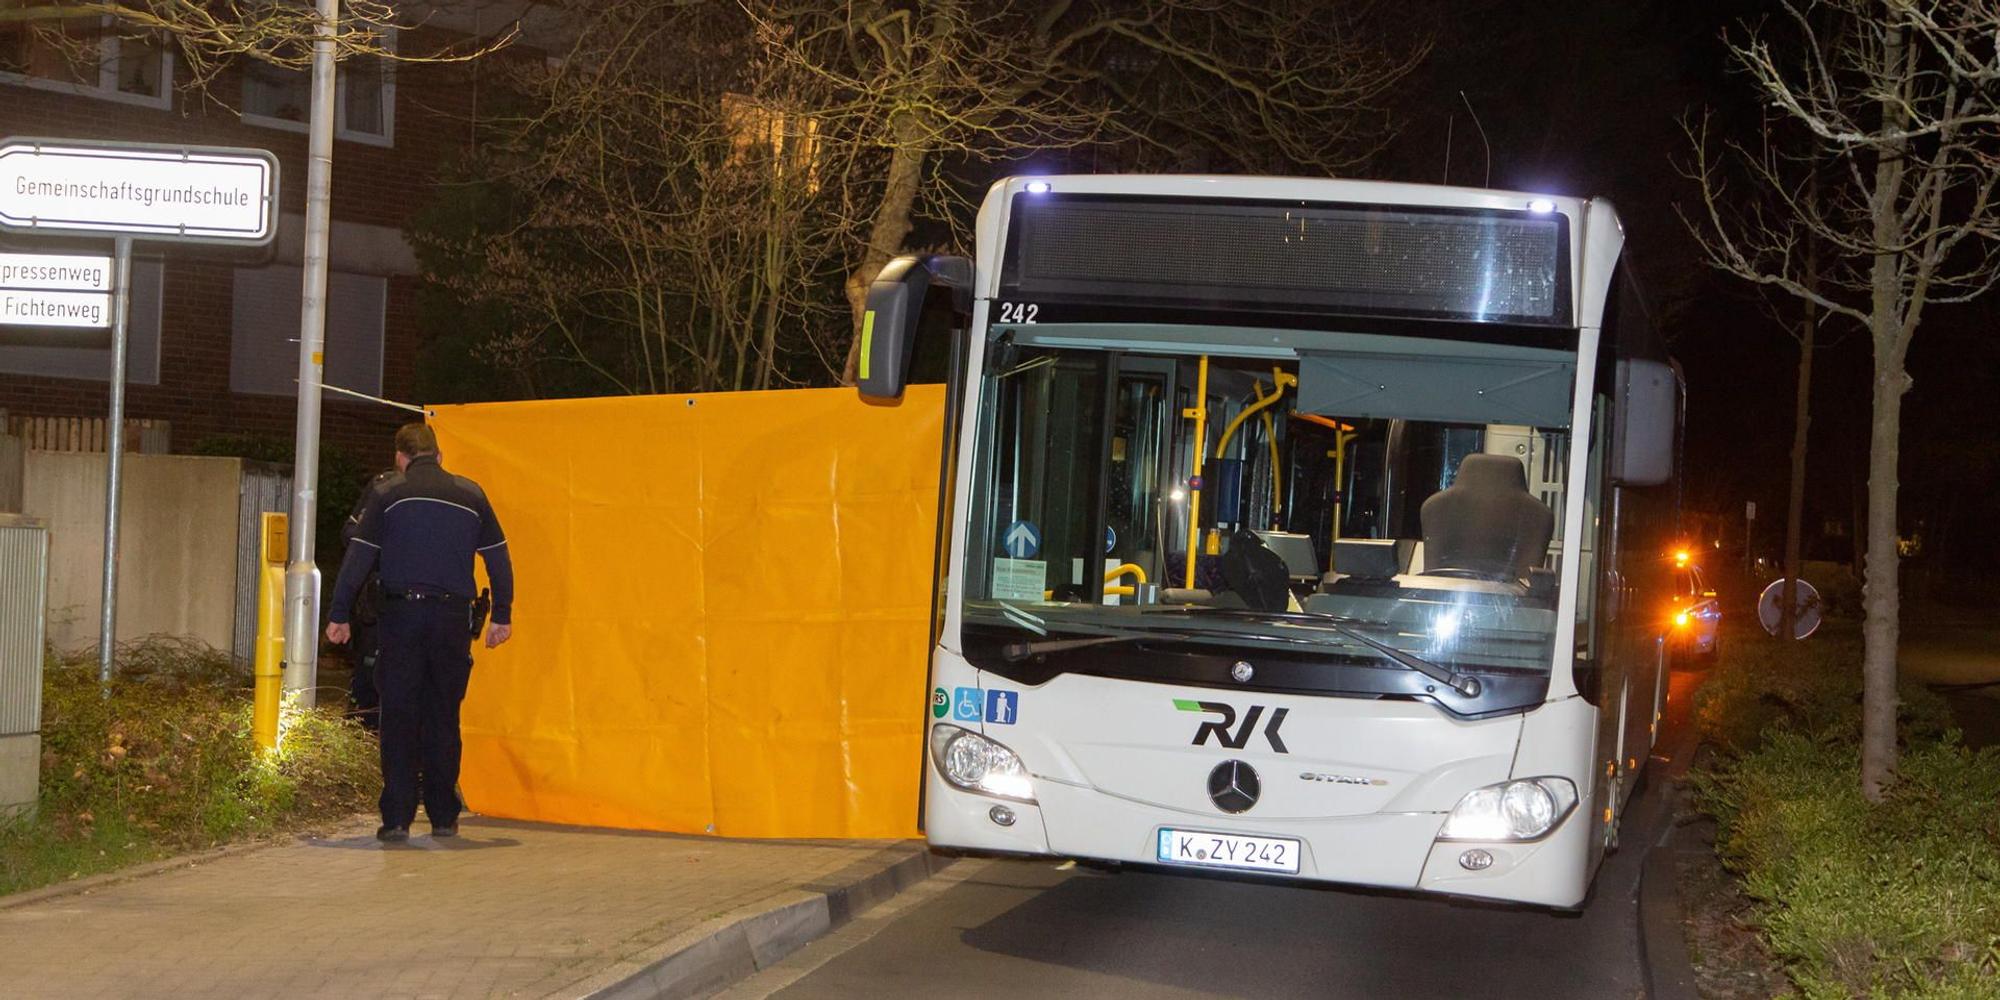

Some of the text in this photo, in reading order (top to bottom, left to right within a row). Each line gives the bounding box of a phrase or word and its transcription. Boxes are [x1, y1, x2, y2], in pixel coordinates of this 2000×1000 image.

[15, 175, 249, 207] Gemeinschaftsgrundschule
[0, 264, 102, 287] pressenweg
[5, 296, 100, 324] Fichtenweg
[1000, 301, 1039, 325] 242
[1180, 836, 1286, 865] K ZY 242
